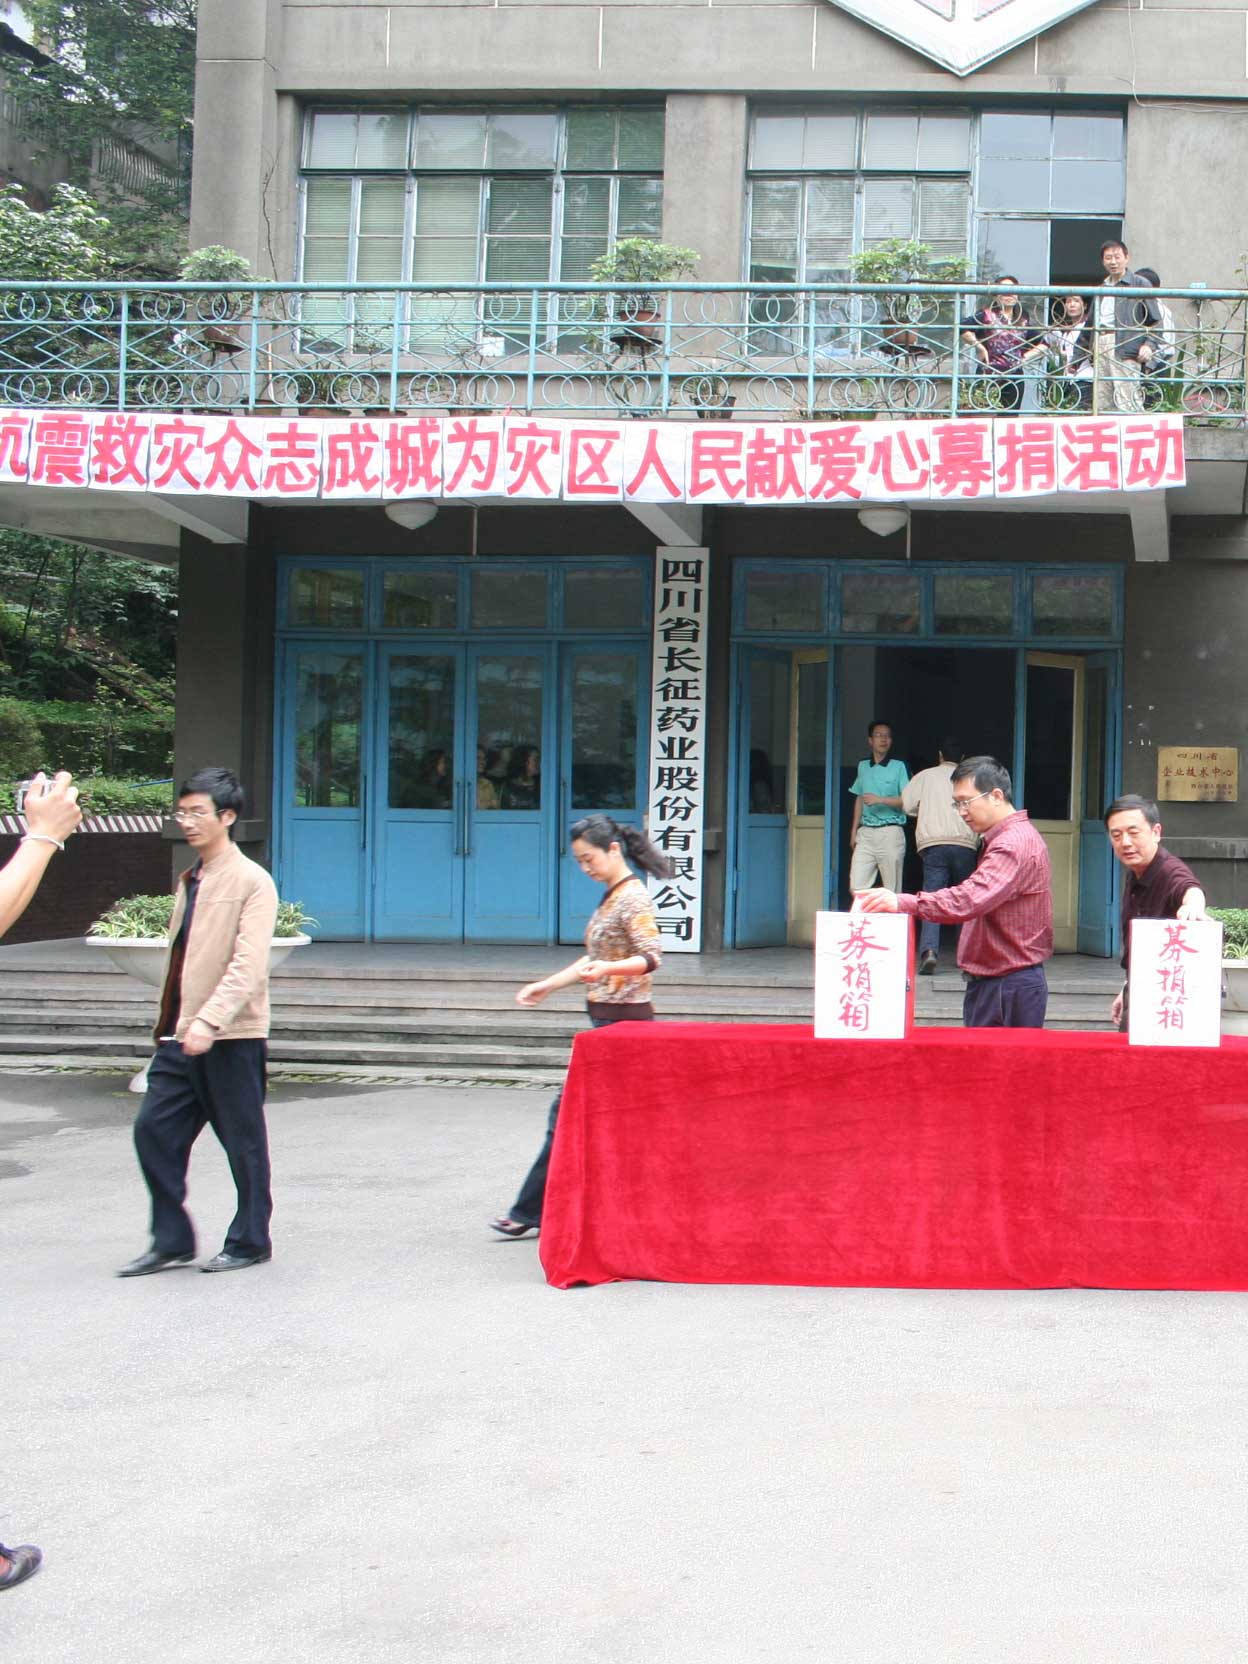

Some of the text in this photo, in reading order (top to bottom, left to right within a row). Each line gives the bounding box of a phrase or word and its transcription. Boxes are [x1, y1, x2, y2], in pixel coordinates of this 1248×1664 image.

[1162, 766, 1234, 778] 企业技术中心
